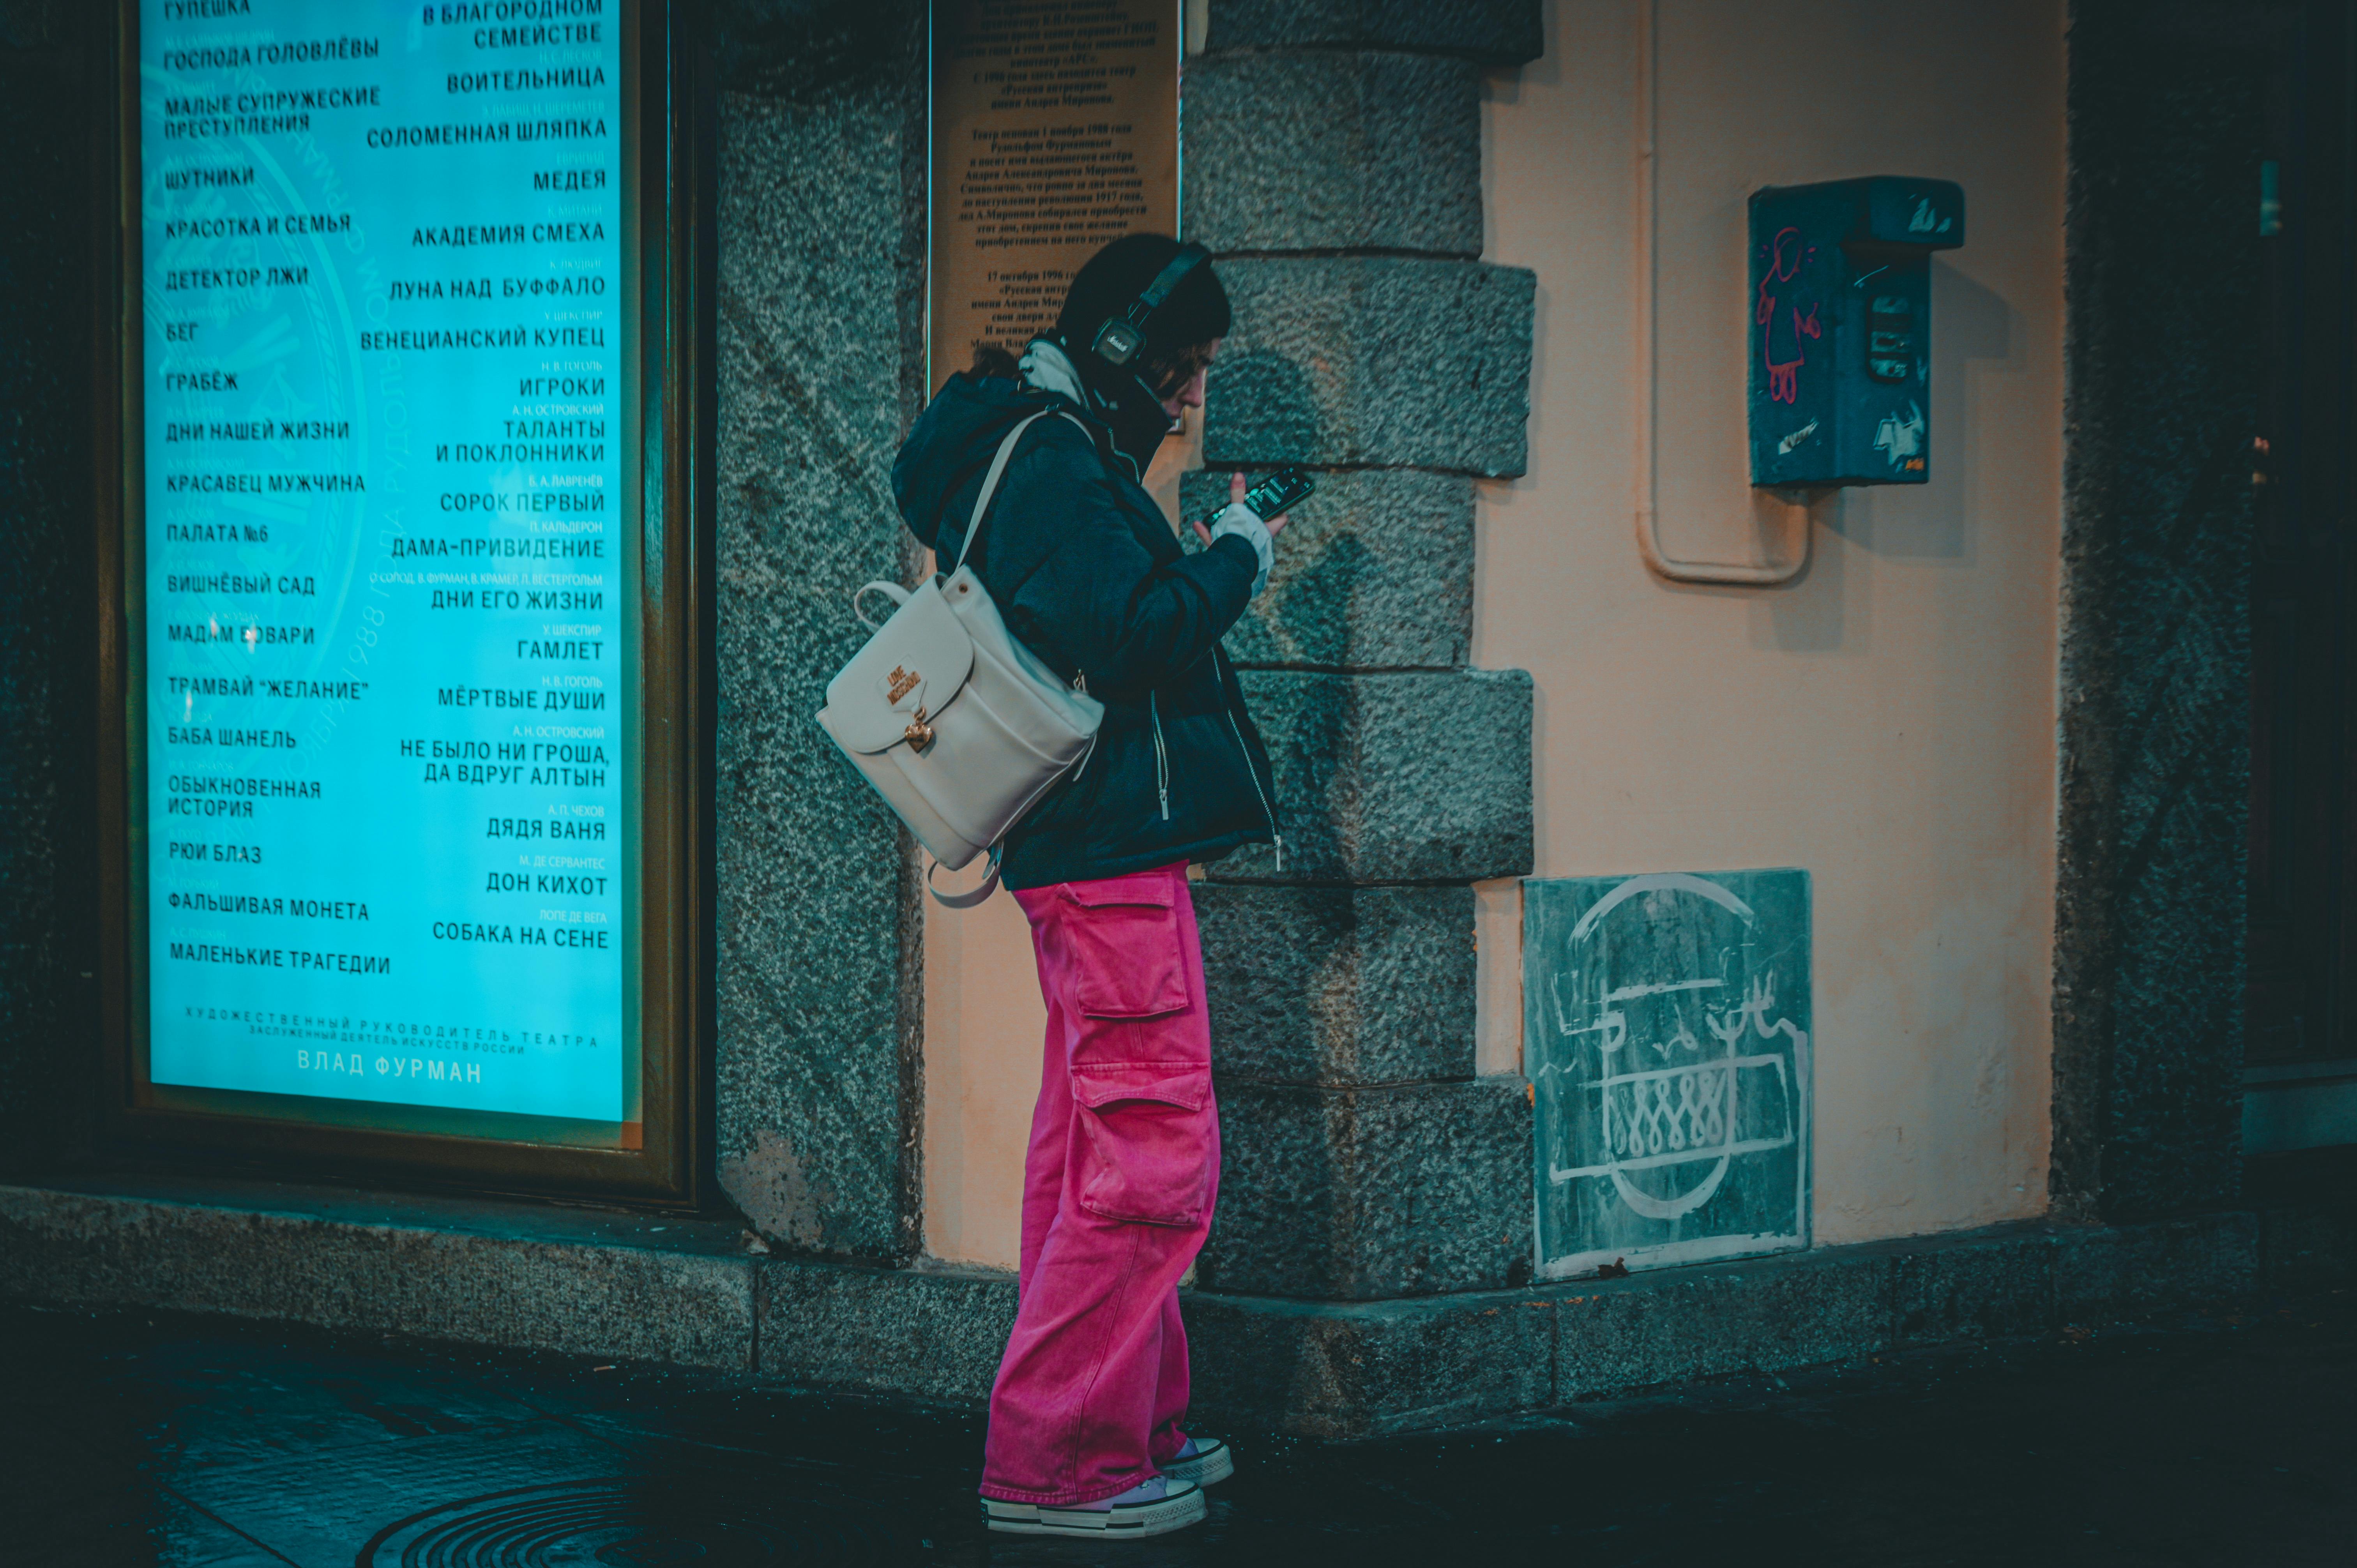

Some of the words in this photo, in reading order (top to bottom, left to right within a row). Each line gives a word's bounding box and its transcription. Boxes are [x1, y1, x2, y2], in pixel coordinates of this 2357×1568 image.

[423, 4, 435, 26] В
[474, 22, 602, 49] СЕМЕЙСТВЕ
[164, 46, 251, 71] ГОСПОДА
[257, 34, 379, 65] ГОЛОВЛЁВЫ
[447, 66, 605, 95] ВОИТЕЛЬНИЦА
[166, 95, 233, 117] МАЛЫЕ
[238, 85, 381, 114] СУПРУЖЕСКИЕ
[165, 114, 309, 140] ПРЕСТУПЛЕНИЯ
[367, 122, 509, 148] СОЛОМЕННАЯ
[516, 118, 606, 141] ШЛЯПКА
[166, 166, 254, 189] ШУТНИКИ
[534, 170, 605, 192] МЕДЕЯ
[166, 216, 261, 239] КРАСОТКА
[267, 216, 278, 235] И
[285, 212, 351, 234] СЕМЬЯ
[412, 223, 525, 248] АКАДЕМИЯ
[532, 222, 605, 243] СМЕХА
[166, 268, 260, 292] ДЕТЕКТОР
[267, 267, 309, 286] ЛЖИ
[389, 281, 443, 300] ЛУНА
[451, 278, 492, 299] НАД
[503, 276, 605, 298] БУФФАЛО
[166, 323, 199, 341] БЕГ
[361, 325, 527, 351] ВЕНЕЦИАНСКИЙ
[534, 328, 604, 348] КУПЕЦ
[166, 369, 239, 392] ГРАБЁЖ
[520, 378, 605, 397] ИГРОКИ
[535, 402, 604, 416] ОСТРОВСКИЙ
[166, 423, 203, 443] ДНИ
[211, 418, 274, 440] НАШЕЙ
[281, 422, 350, 440] ЖИЗНИ
[504, 420, 605, 439] ТАЛАНТЫ
[436, 444, 448, 462] И
[456, 443, 604, 463] ПОКЛОННИКИ
[167, 474, 262, 494] КРАСАВЕЦ
[269, 474, 366, 493] МУЖЧИНА
[441, 493, 509, 511] СОРОК
[517, 490, 604, 512] ПЕРВЫЙ
[167, 524, 239, 542] ПАЛАТА
[542, 521, 603, 535] КАЛЬДЕРОН
[392, 538, 605, 560] ДАМА-ПРИВИДЕНИЕ
[168, 571, 272, 594] ВИШНЁВЫЙ
[278, 576, 316, 596] САД
[432, 590, 474, 610] ДНИ
[482, 590, 519, 609] ЕГО
[526, 591, 603, 610] ЖИЗНИ
[553, 624, 602, 636] ШЕКСПИР
[342, 606, 385, 682] 1988
[518, 640, 604, 660] ГАМЛЕТ
[168, 675, 254, 697] ТРАМВАЙ
[565, 676, 603, 688] ГОГОЛЬ
[438, 685, 538, 707] МЁРТВЫЕ
[544, 691, 605, 711] ДУШИ
[168, 726, 213, 745] БАБА
[219, 728, 297, 748] ШАНЕЛЬ
[536, 726, 604, 739] ОСТРОВСКИЙ
[401, 740, 426, 757] НЕ
[433, 741, 490, 759] БЫЛО
[499, 743, 526, 761] НИ
[534, 744, 610, 767] ГРОША,
[425, 764, 450, 782] ДА
[458, 765, 525, 785] ВДРУГ
[530, 767, 605, 786] АЛТЫН
[168, 775, 322, 798] ОБЫКНОВЕННАЯ
[168, 798, 253, 818] ИСТОРИЯ
[572, 805, 604, 818] ЧЕХОВ
[487, 818, 542, 839] ДЯДЯ
[551, 821, 605, 841] ВАНЯ
[169, 842, 207, 861] РЮИ
[214, 845, 263, 864] БЛАЗ
[534, 856, 546, 868] ДЕ
[548, 856, 605, 870] СЕРВАНТЕС
[487, 873, 529, 892] ДОН
[538, 875, 607, 895] КИХОТ
[168, 892, 283, 915] ФАЛЬШИВАЯ
[290, 900, 369, 920] МОНЕТА
[539, 909, 566, 922] ЛОПЕ
[569, 911, 581, 924] ДЕ
[584, 912, 607, 924] ВЕГА
[433, 922, 513, 943] СОБАКА
[521, 927, 546, 945] НА
[554, 929, 608, 948] СЕНЕ
[170, 942, 284, 968] МАЛЕНЬКИЕ
[289, 951, 390, 975] ТРАГЕДИИ
[185, 1006, 350, 1030] ХУДОЖЕСТВЕННЫЙ
[361, 1020, 510, 1042] РУКОВОДИТЕЛЬ
[522, 1033, 597, 1048] ТЕАТРА
[249, 1025, 337, 1040] ЗАСЛУЖЕННЫЙ
[341, 1033, 398, 1045] ДЕЯТЕЛЬ
[402, 1038, 468, 1051] ИСКУССТВ
[474, 1043, 525, 1055] РОССИИ
[298, 1050, 364, 1076] ВЛАД
[375, 1056, 481, 1083] ФУРМАН
